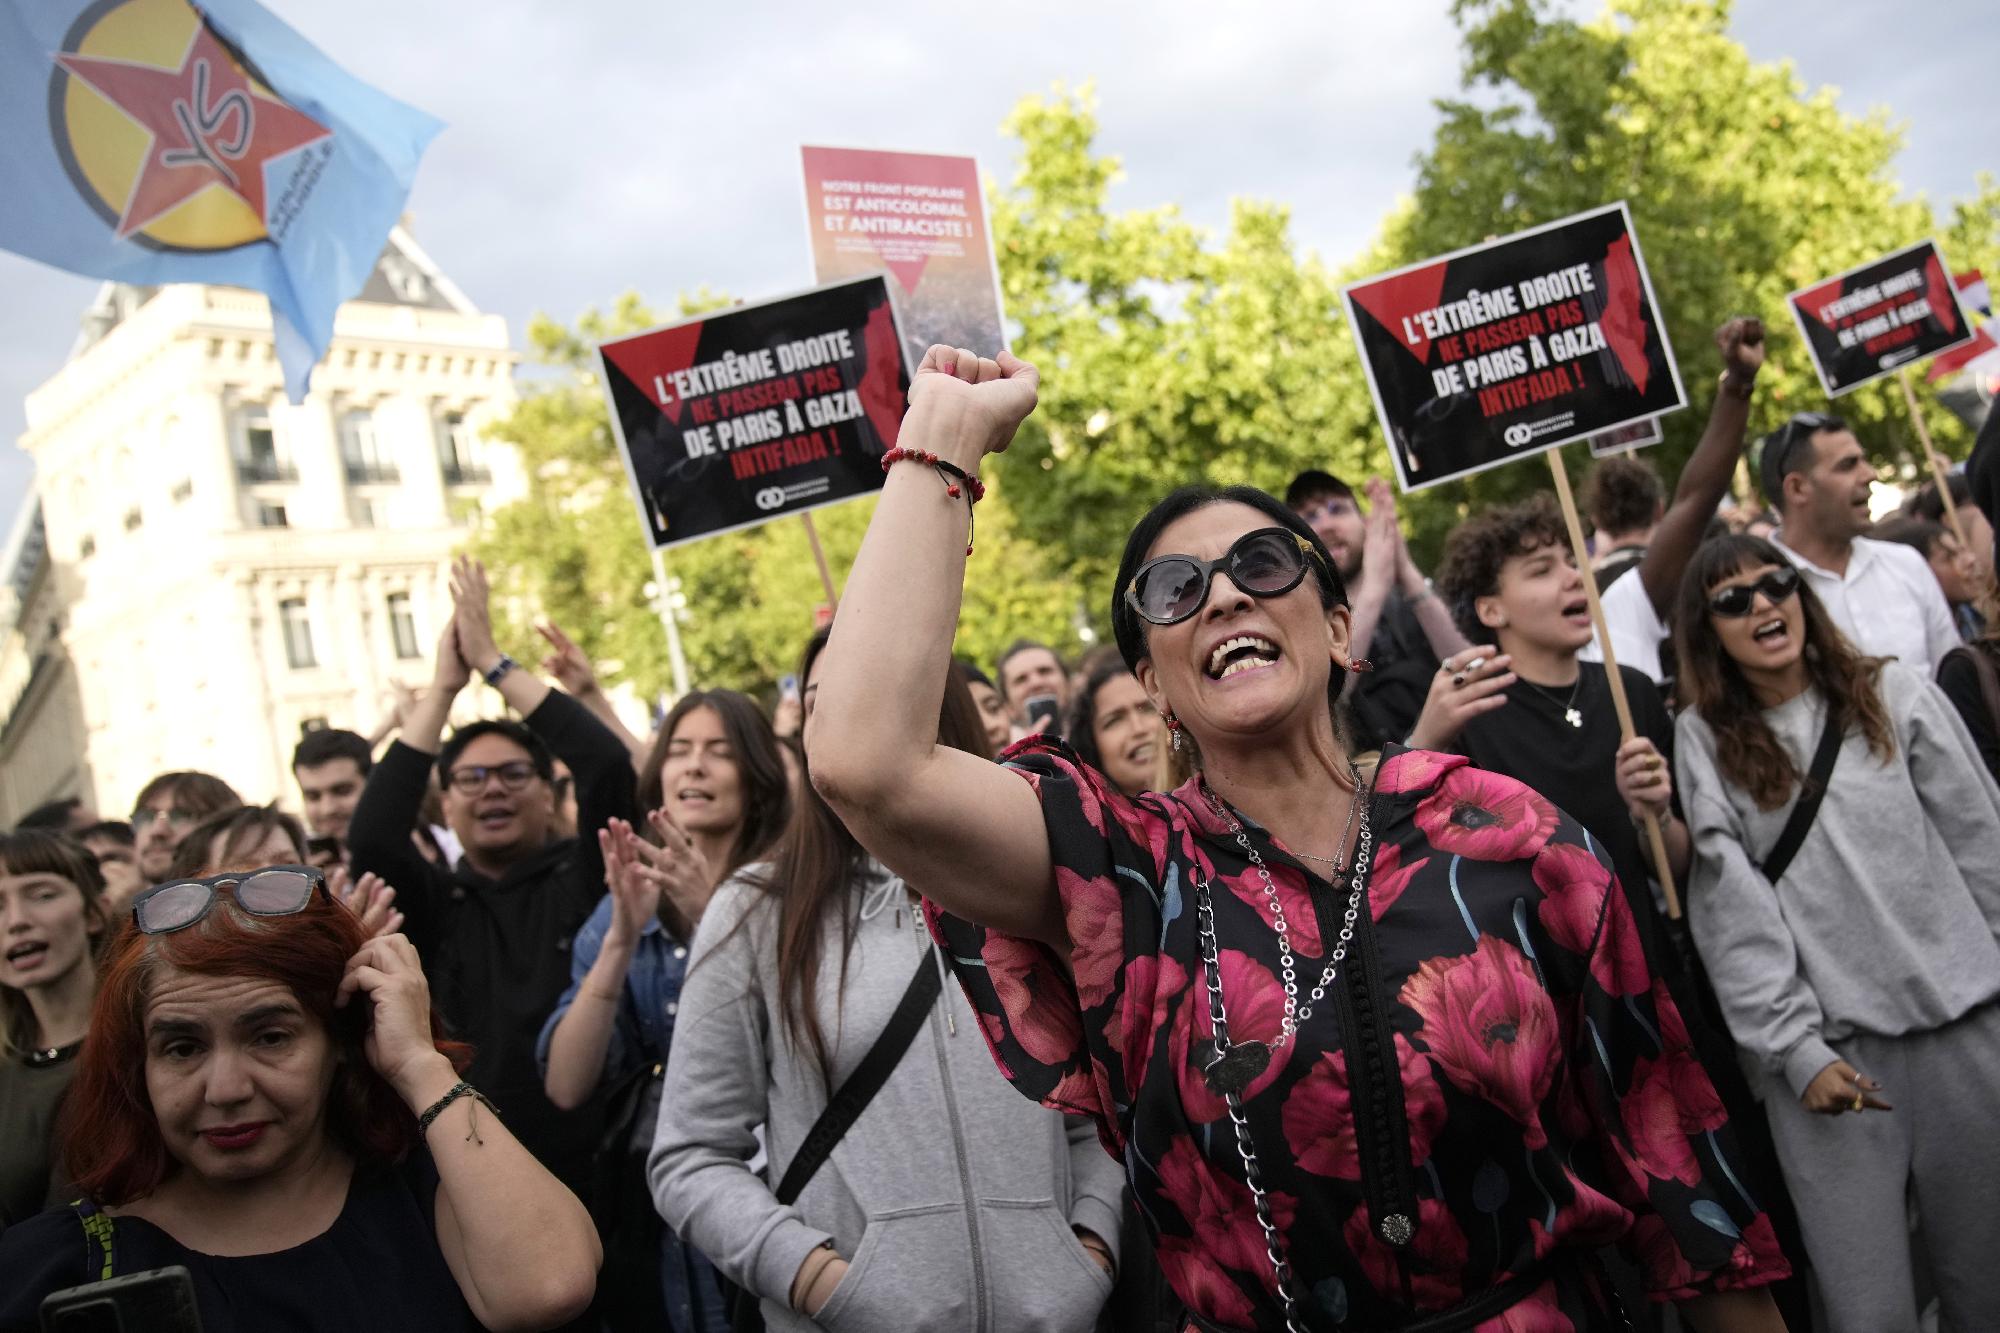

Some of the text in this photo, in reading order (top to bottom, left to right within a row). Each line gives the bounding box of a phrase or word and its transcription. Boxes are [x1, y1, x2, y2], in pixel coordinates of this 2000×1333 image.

[821, 180, 965, 199] NOTRE FRONT POPULAIRE
[823, 196, 968, 218] EST ANTICOLONIAL
[824, 217, 845, 232] ET
[849, 218, 964, 237] ANTIRACISTE
[1401, 262, 1595, 344] L'EXTRÊME DROITE
[1432, 321, 1607, 398] DE PARIS À GAZA
[1438, 300, 1584, 363] NE PASSERA PAS
[654, 329, 854, 405] L'EXTRÊME DROITE
[1478, 363, 1586, 417] INTIFADA !
[691, 368, 842, 424] NE PASSERA PAS
[683, 390, 865, 459] DE PARIS À GAZA
[730, 431, 842, 481] INTIFADA !
